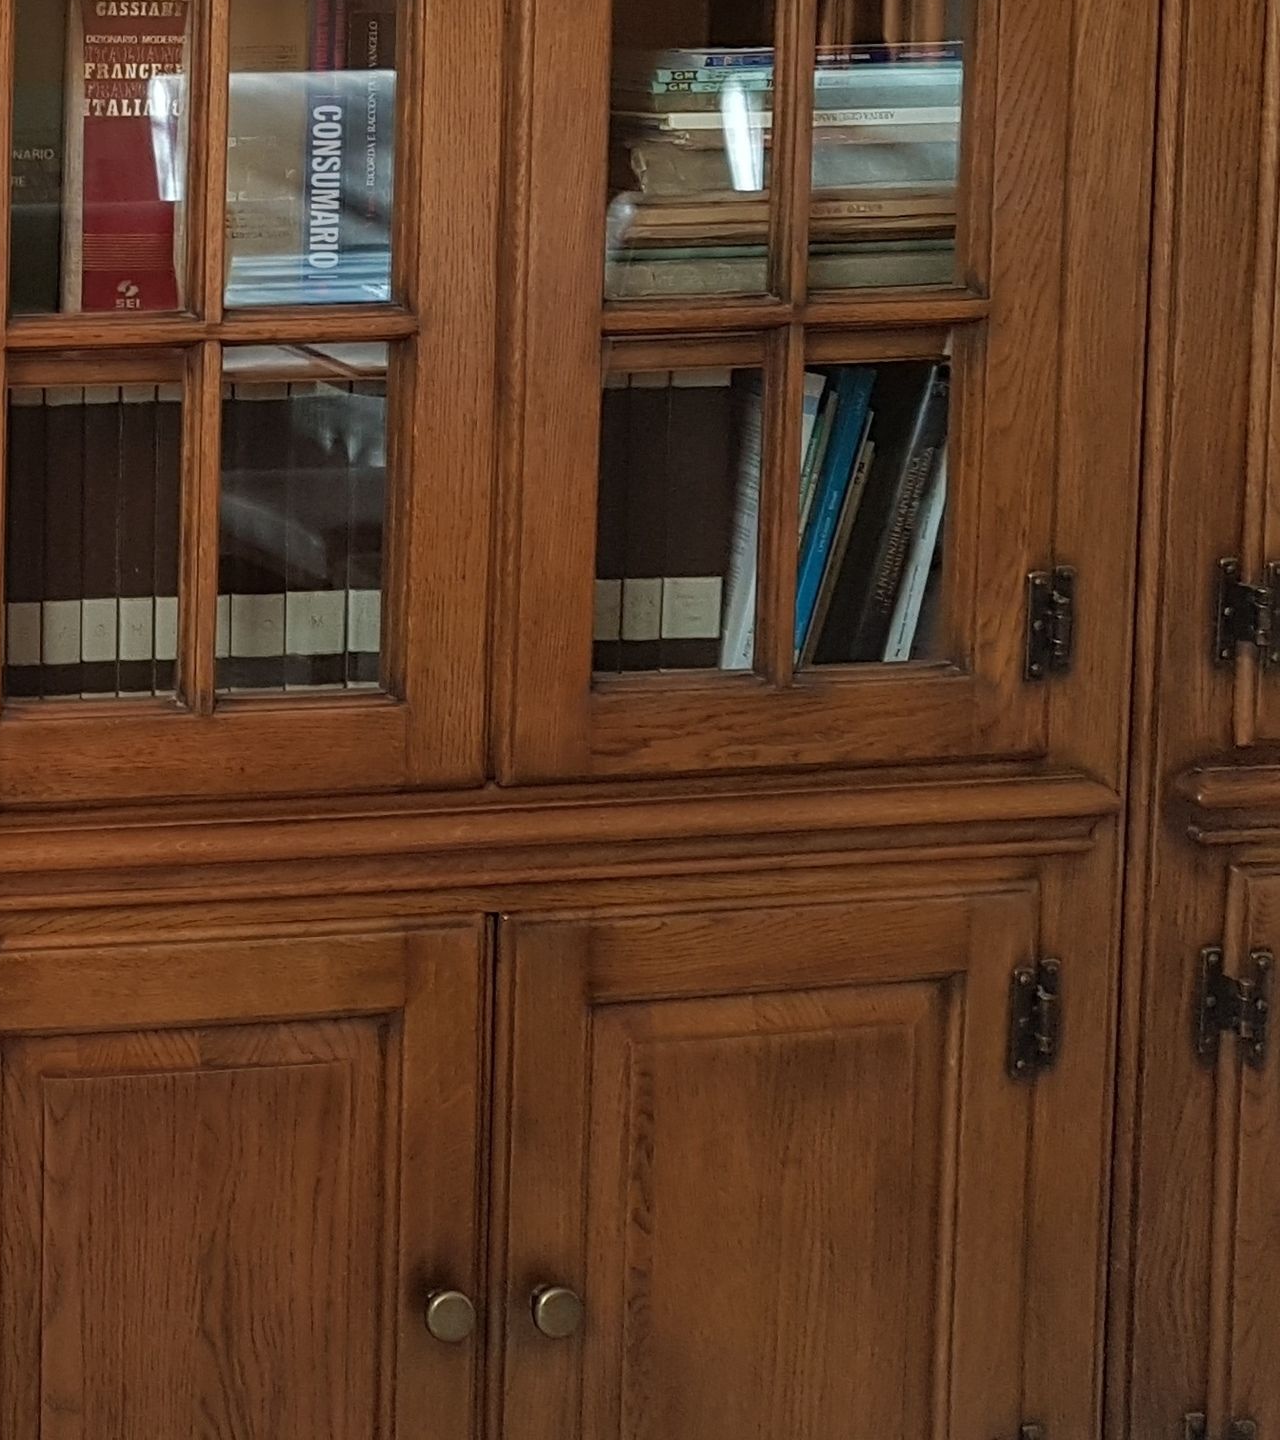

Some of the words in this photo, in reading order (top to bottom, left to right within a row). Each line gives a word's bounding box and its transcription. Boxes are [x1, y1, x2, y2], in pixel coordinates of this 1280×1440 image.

[96, 1, 183, 17] CASSIANI
[86, 35, 138, 44] DIZIONARIO
[142, 35, 188, 45] MODERNO
[369, 21, 378, 67] VANGELO
[675, 71, 694, 80] GM
[669, 82, 689, 91] GM
[367, 82, 378, 132] RACCONTA
[366, 143, 377, 186] RICORDA
[307, 105, 342, 268] CONSUMARIO
[115, 298, 141, 309] SEI
